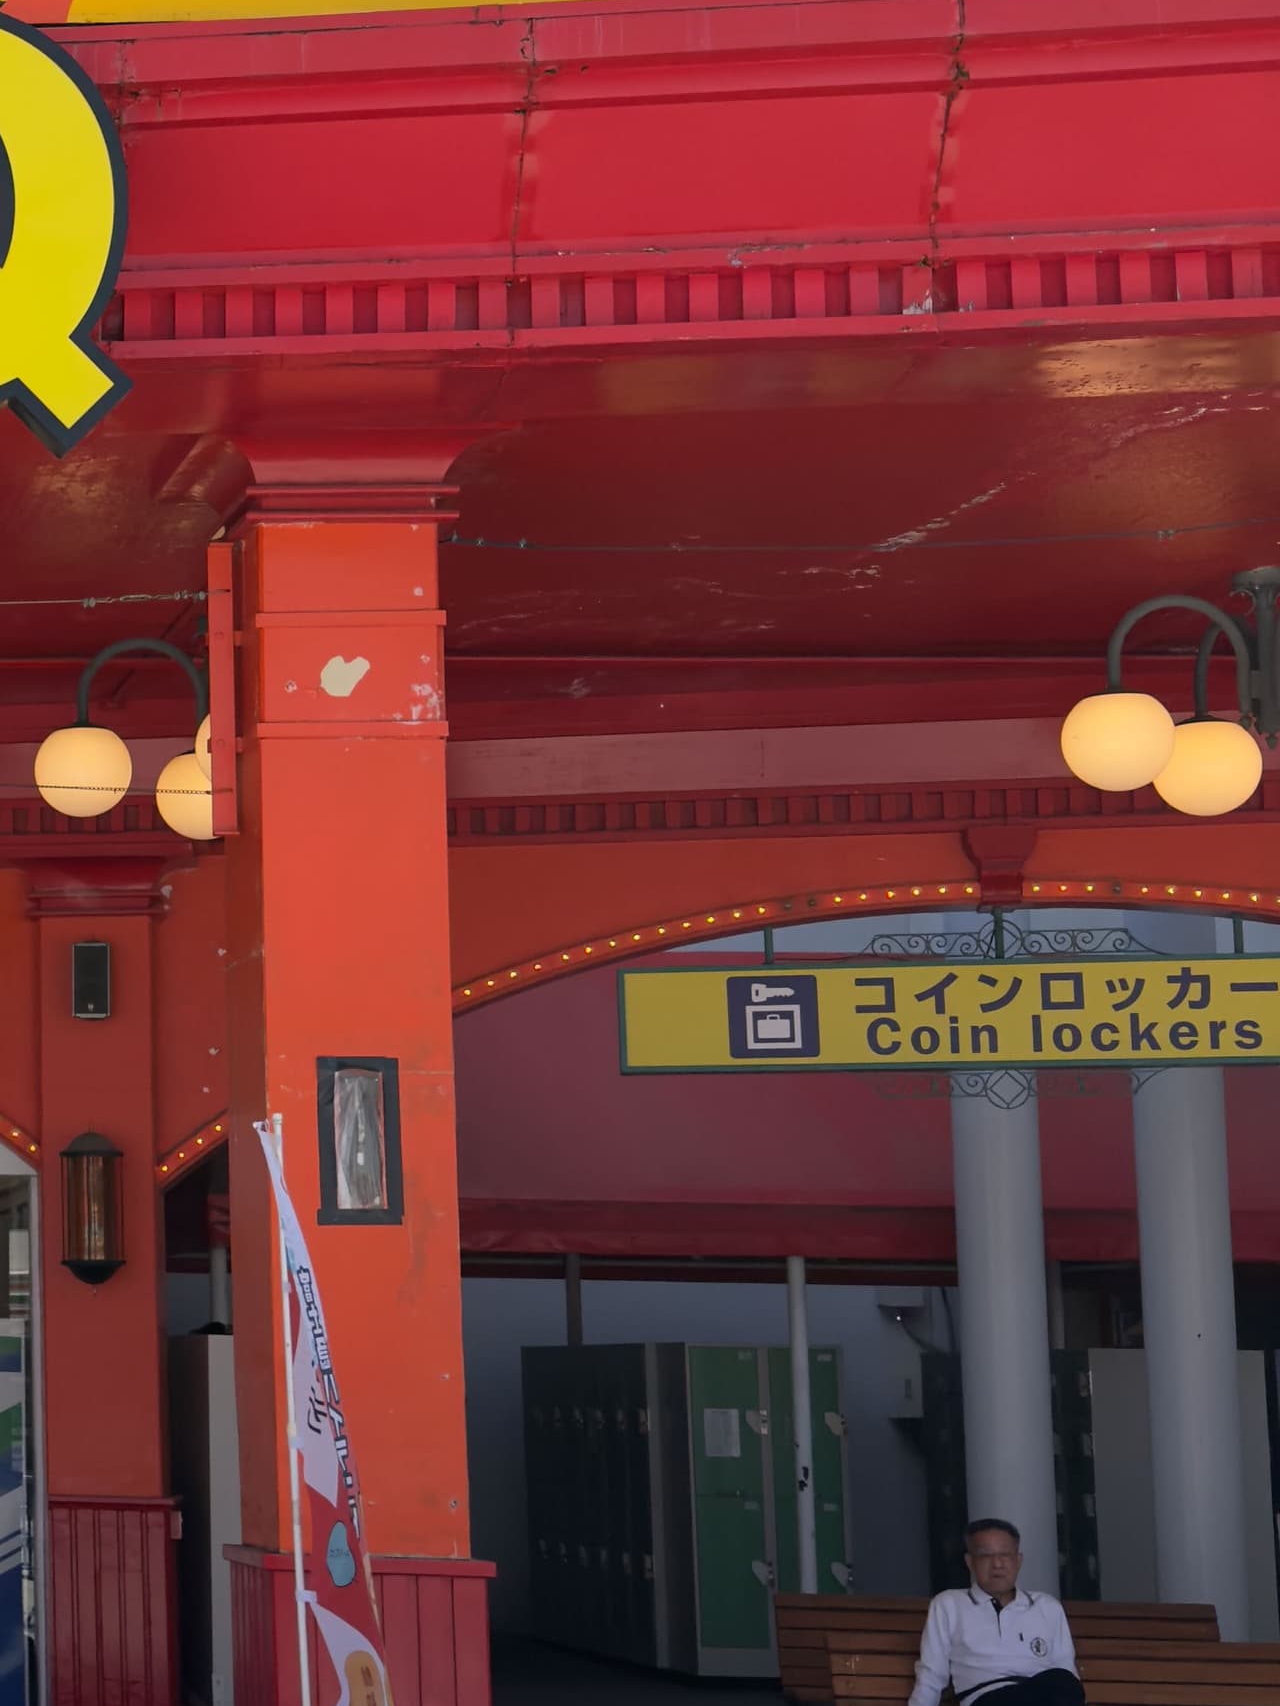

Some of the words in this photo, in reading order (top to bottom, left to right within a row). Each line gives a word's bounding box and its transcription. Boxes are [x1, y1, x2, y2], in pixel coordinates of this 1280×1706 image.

[854, 967, 1280, 1014] コインロッカー
[866, 1016, 1000, 1056] Coin
[1032, 1011, 1264, 1054] lockers
